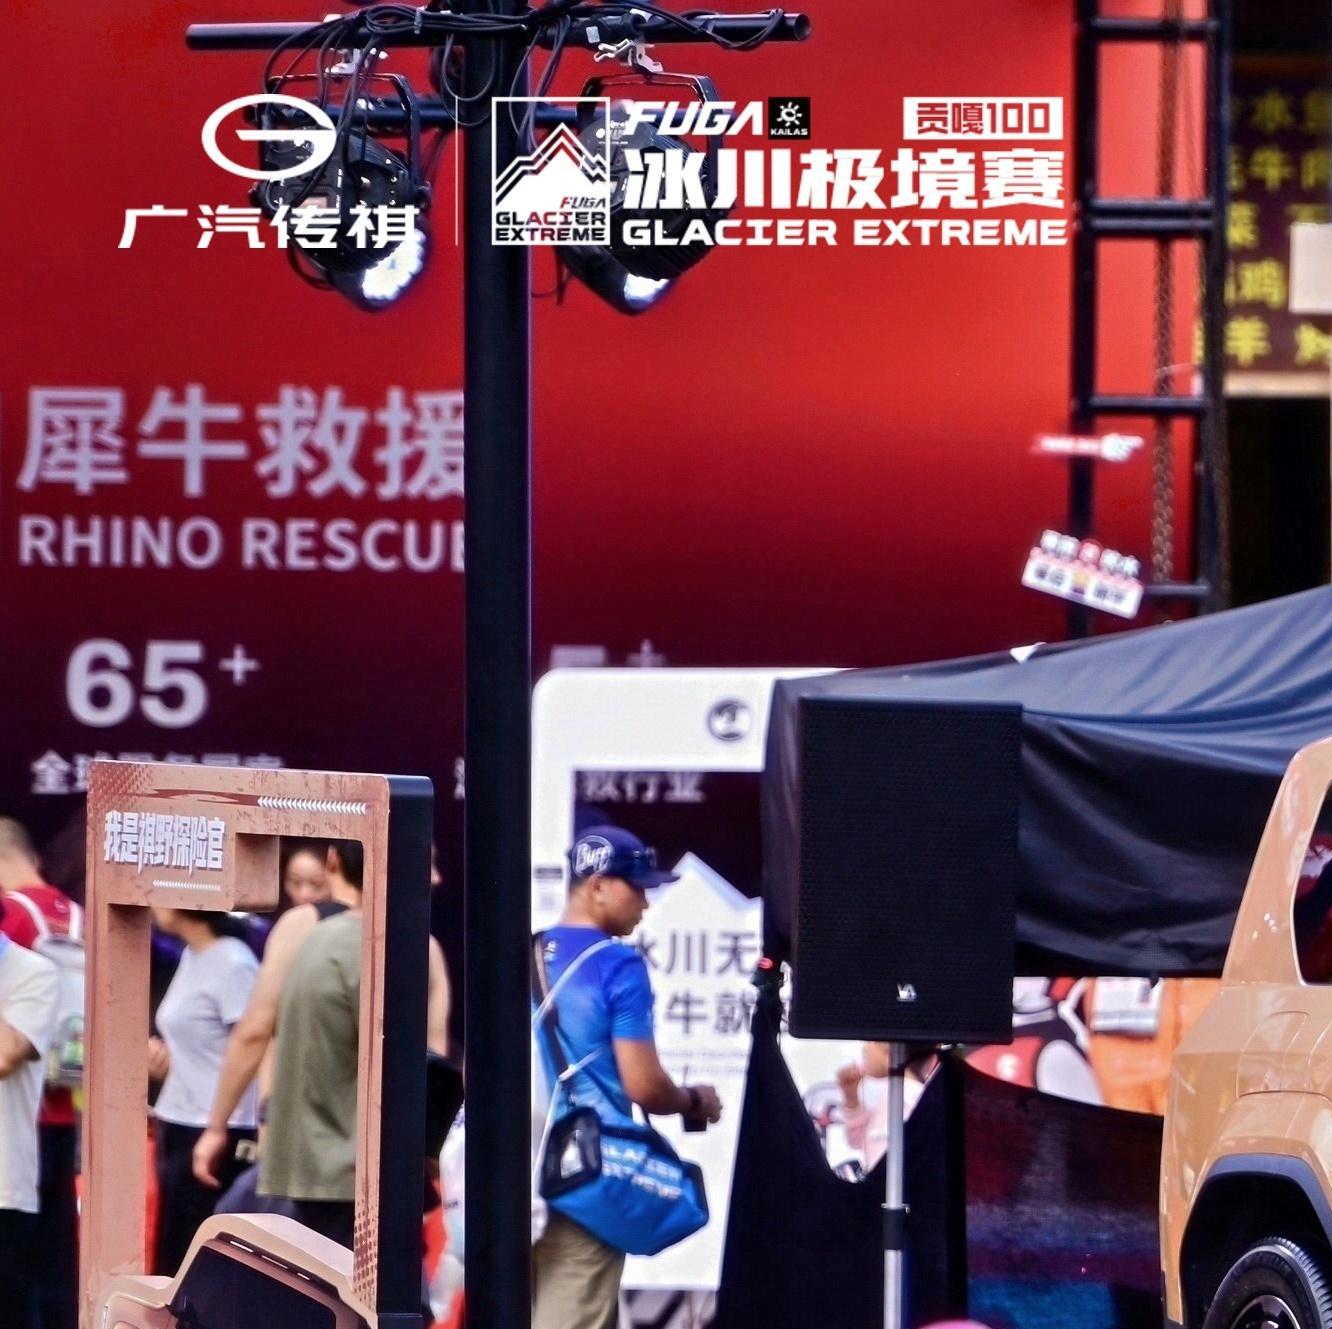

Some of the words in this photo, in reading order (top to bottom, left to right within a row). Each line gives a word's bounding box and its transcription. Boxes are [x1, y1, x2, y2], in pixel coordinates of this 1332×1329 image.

[16, 384, 465, 499] 犀牛救援
[19, 516, 222, 568] RHINO
